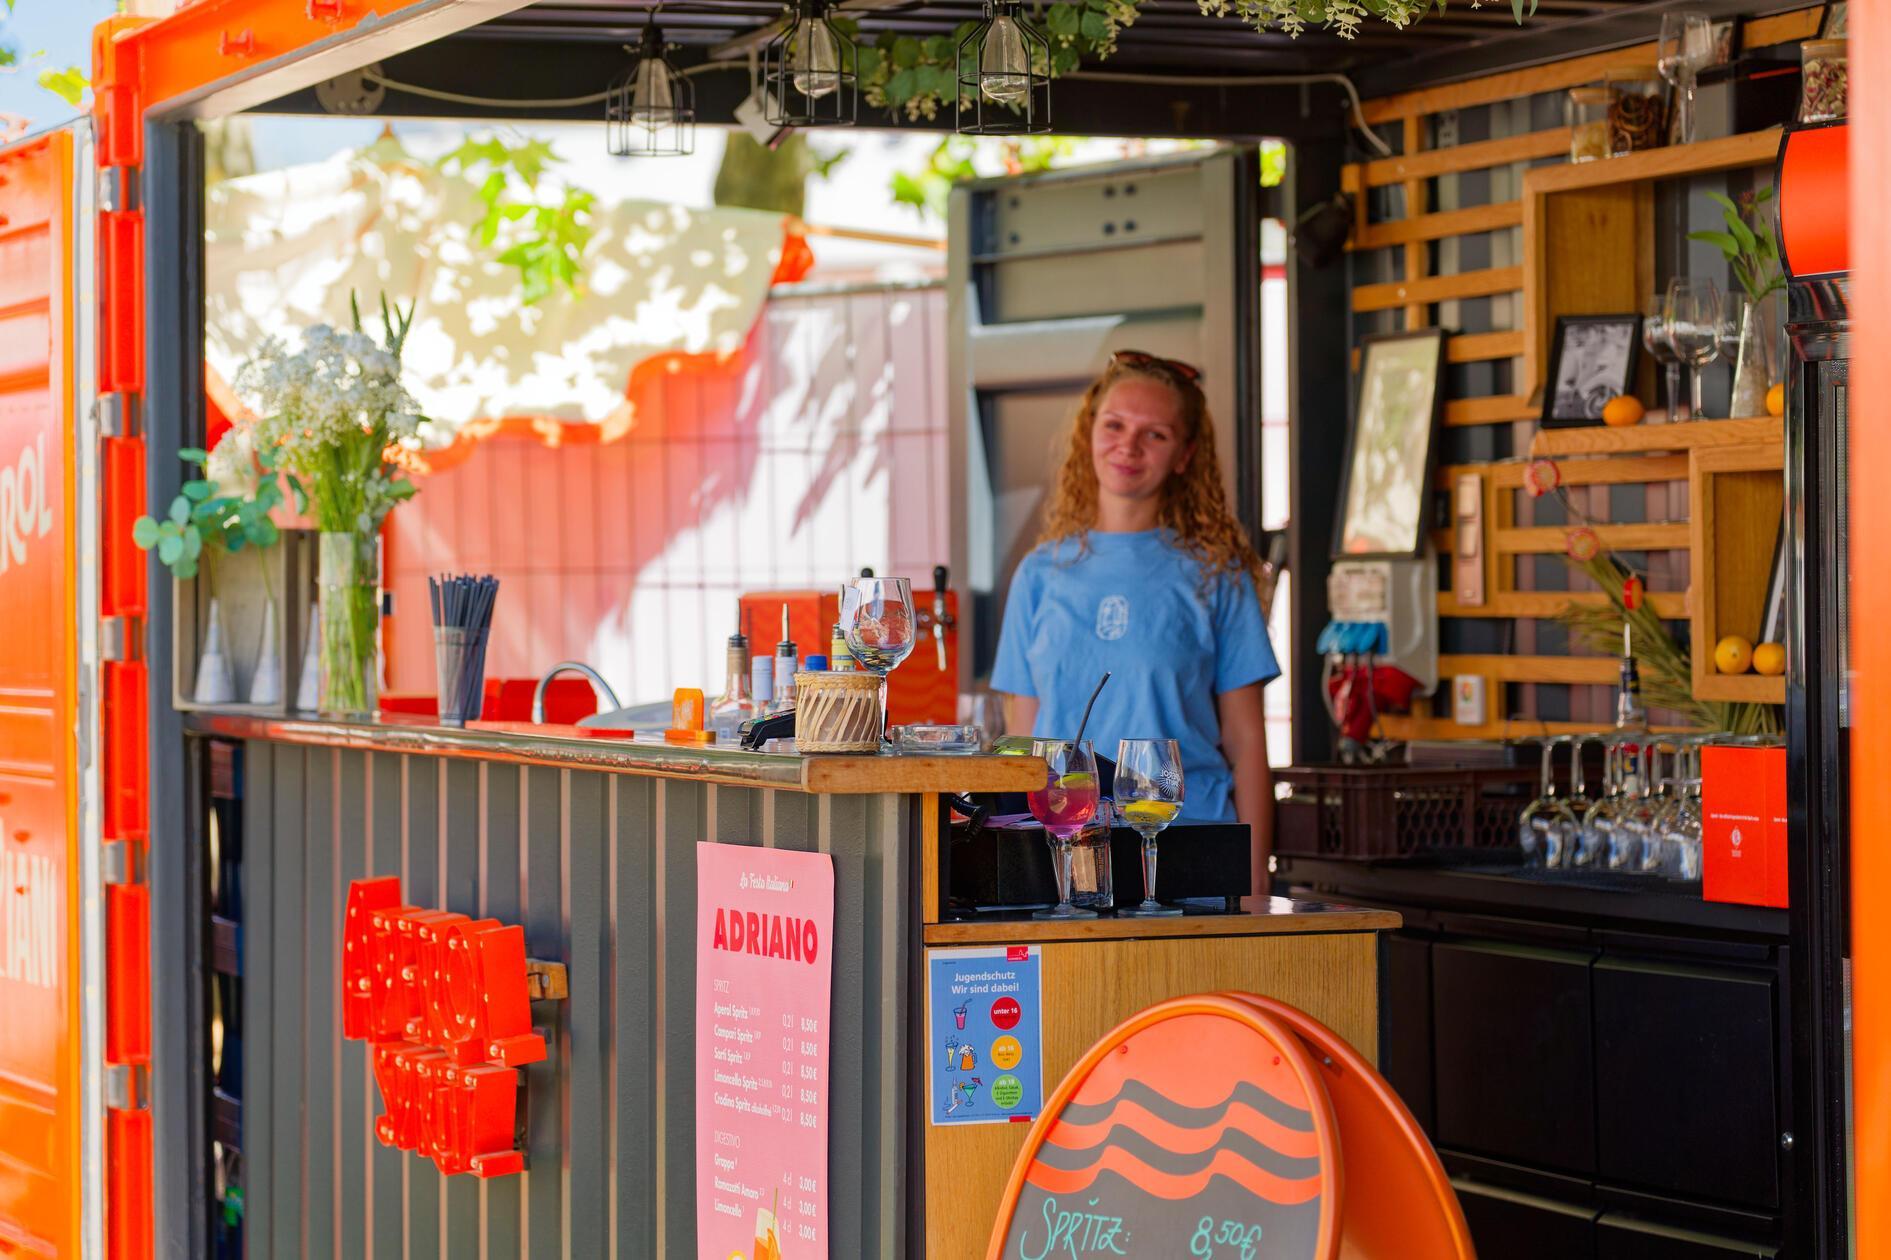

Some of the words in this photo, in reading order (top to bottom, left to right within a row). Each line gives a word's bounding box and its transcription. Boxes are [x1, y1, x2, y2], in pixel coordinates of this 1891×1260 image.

[713, 908, 818, 965] ADRIANO
[954, 970, 1016, 983] Jugendschutz
[713, 978, 730, 994] SPRITZ
[951, 985, 968, 994] Wir
[970, 984, 988, 993] sind
[991, 982, 1019, 993] dabei!
[713, 1002, 731, 1018] Aperol
[732, 1005, 748, 1021] Spritz
[713, 1023, 737, 1041] Campari
[737, 1028, 753, 1045] Spritz
[727, 1049, 743, 1066] Spritz
[742, 1075, 758, 1092] Spritz
[735, 1096, 751, 1113] Spritz
